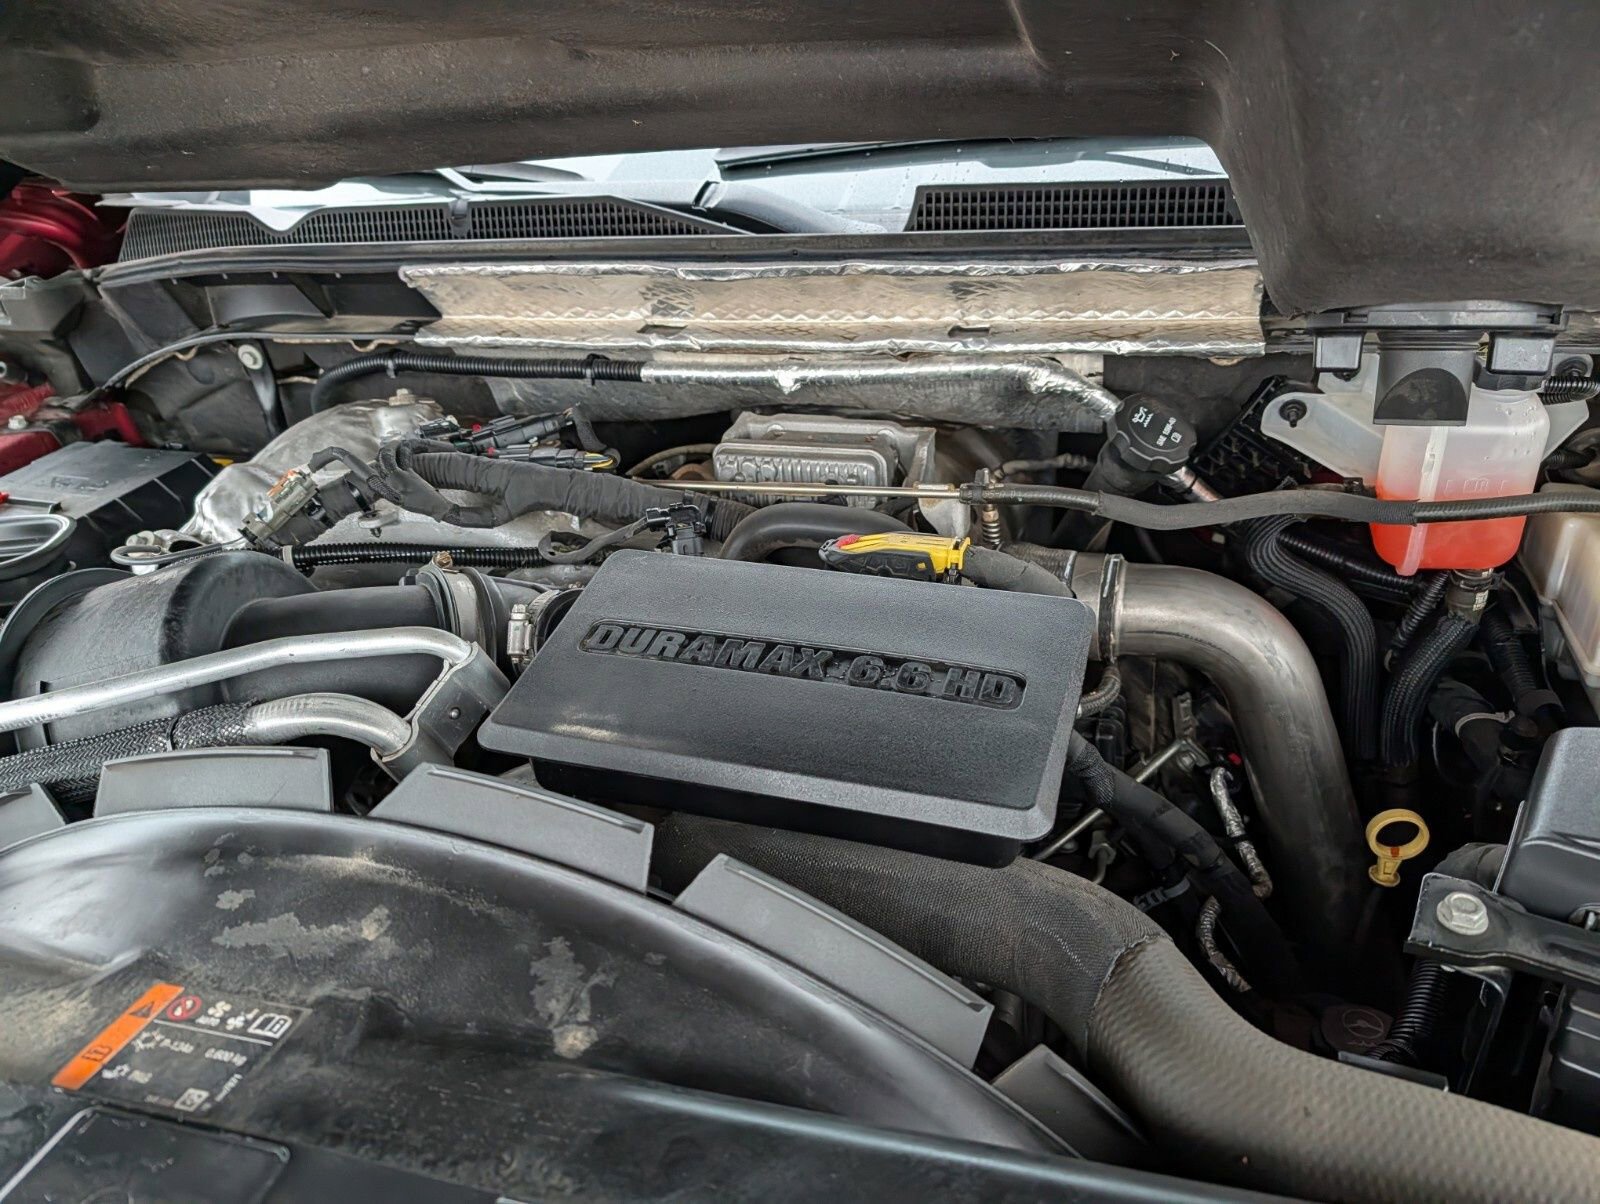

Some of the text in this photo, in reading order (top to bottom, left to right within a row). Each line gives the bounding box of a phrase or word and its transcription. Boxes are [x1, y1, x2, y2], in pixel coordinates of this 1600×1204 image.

[592, 622, 1019, 704] DURAMAX 6.6 HD
